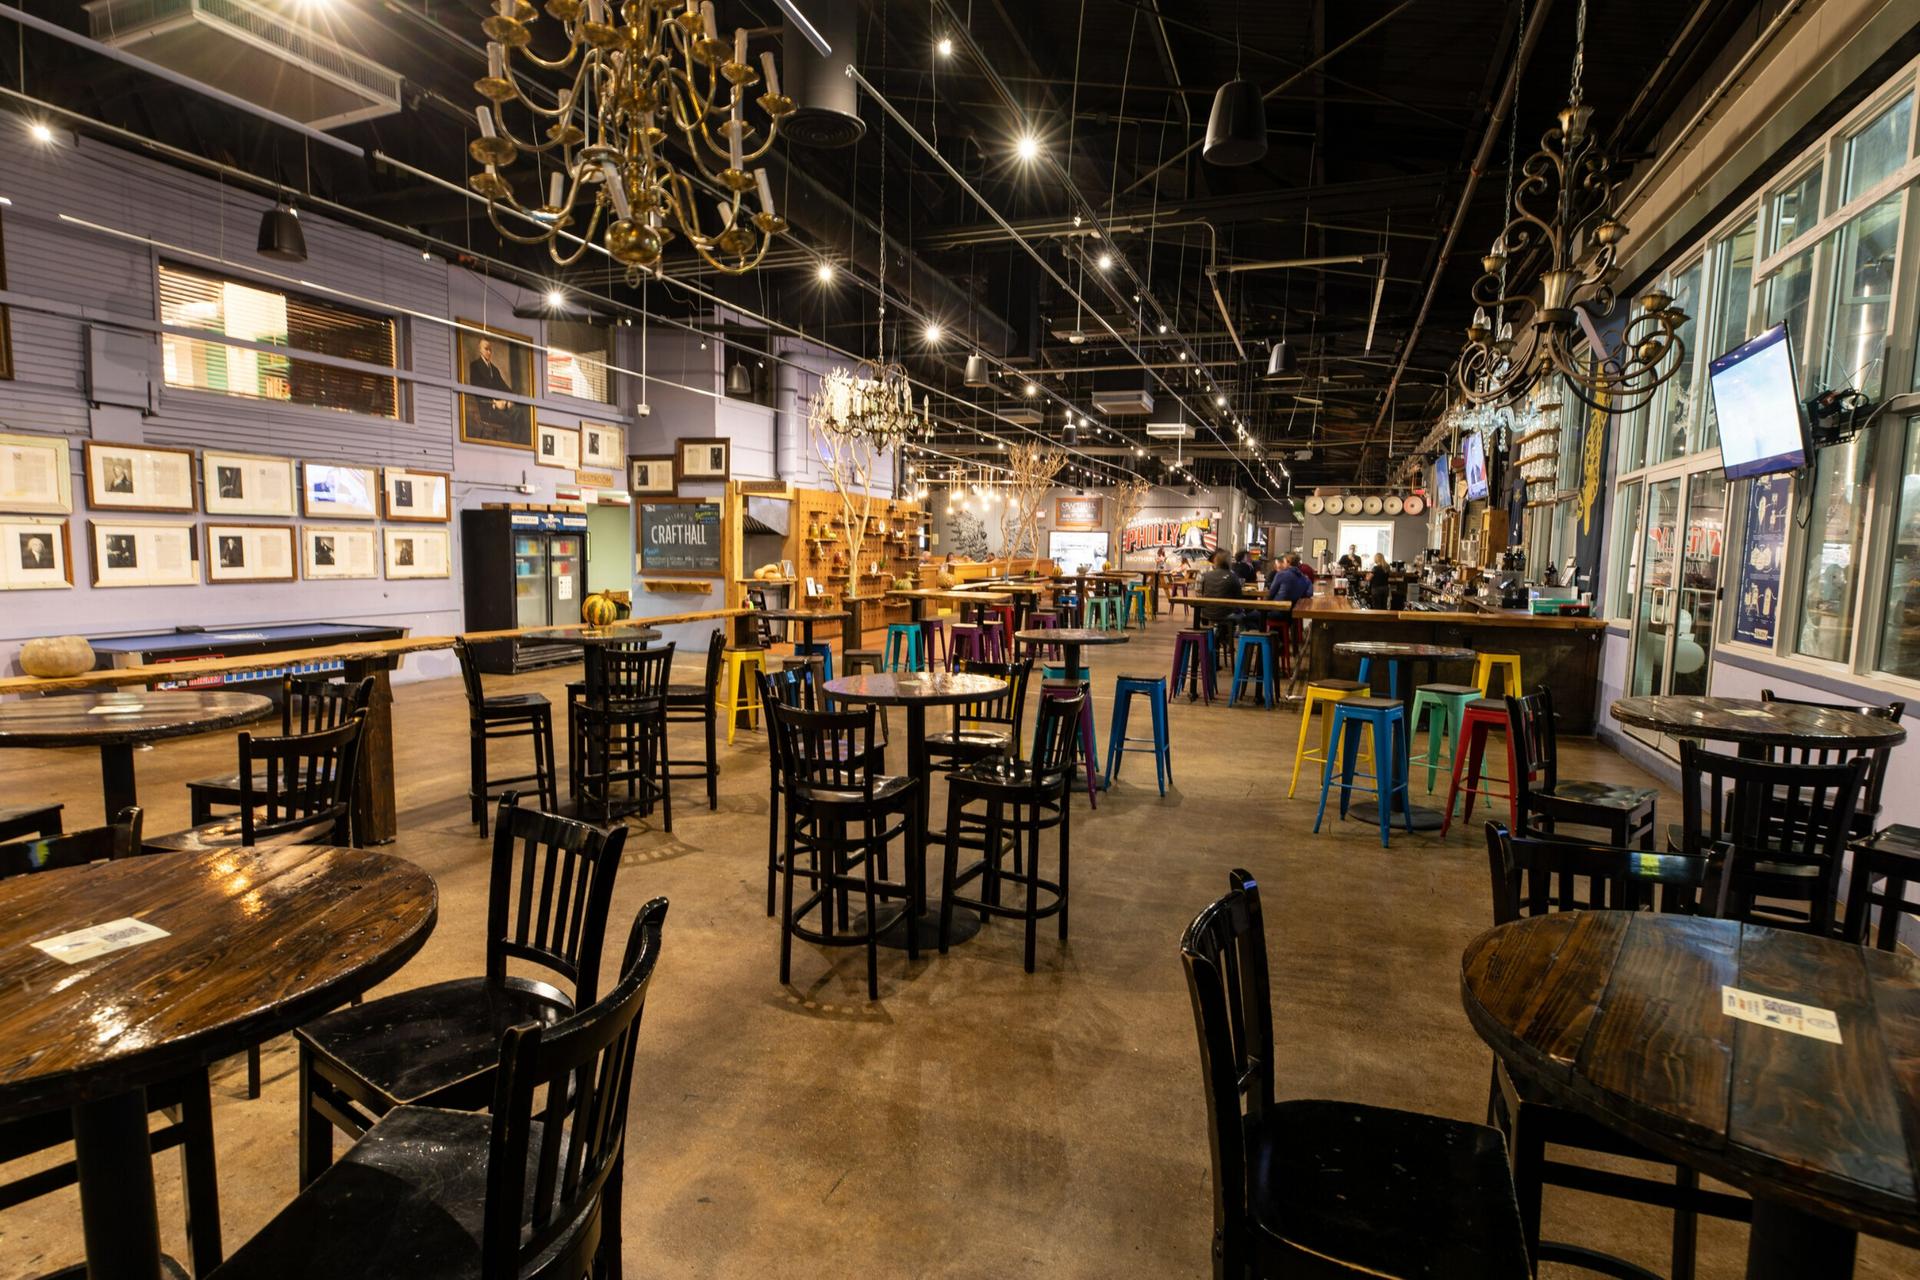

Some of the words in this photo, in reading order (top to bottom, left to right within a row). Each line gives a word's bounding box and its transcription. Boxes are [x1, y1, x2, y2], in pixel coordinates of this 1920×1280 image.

[651, 525, 683, 544] CRAFT
[684, 524, 707, 544] HALL
[1125, 523, 1181, 552] PHILLY
